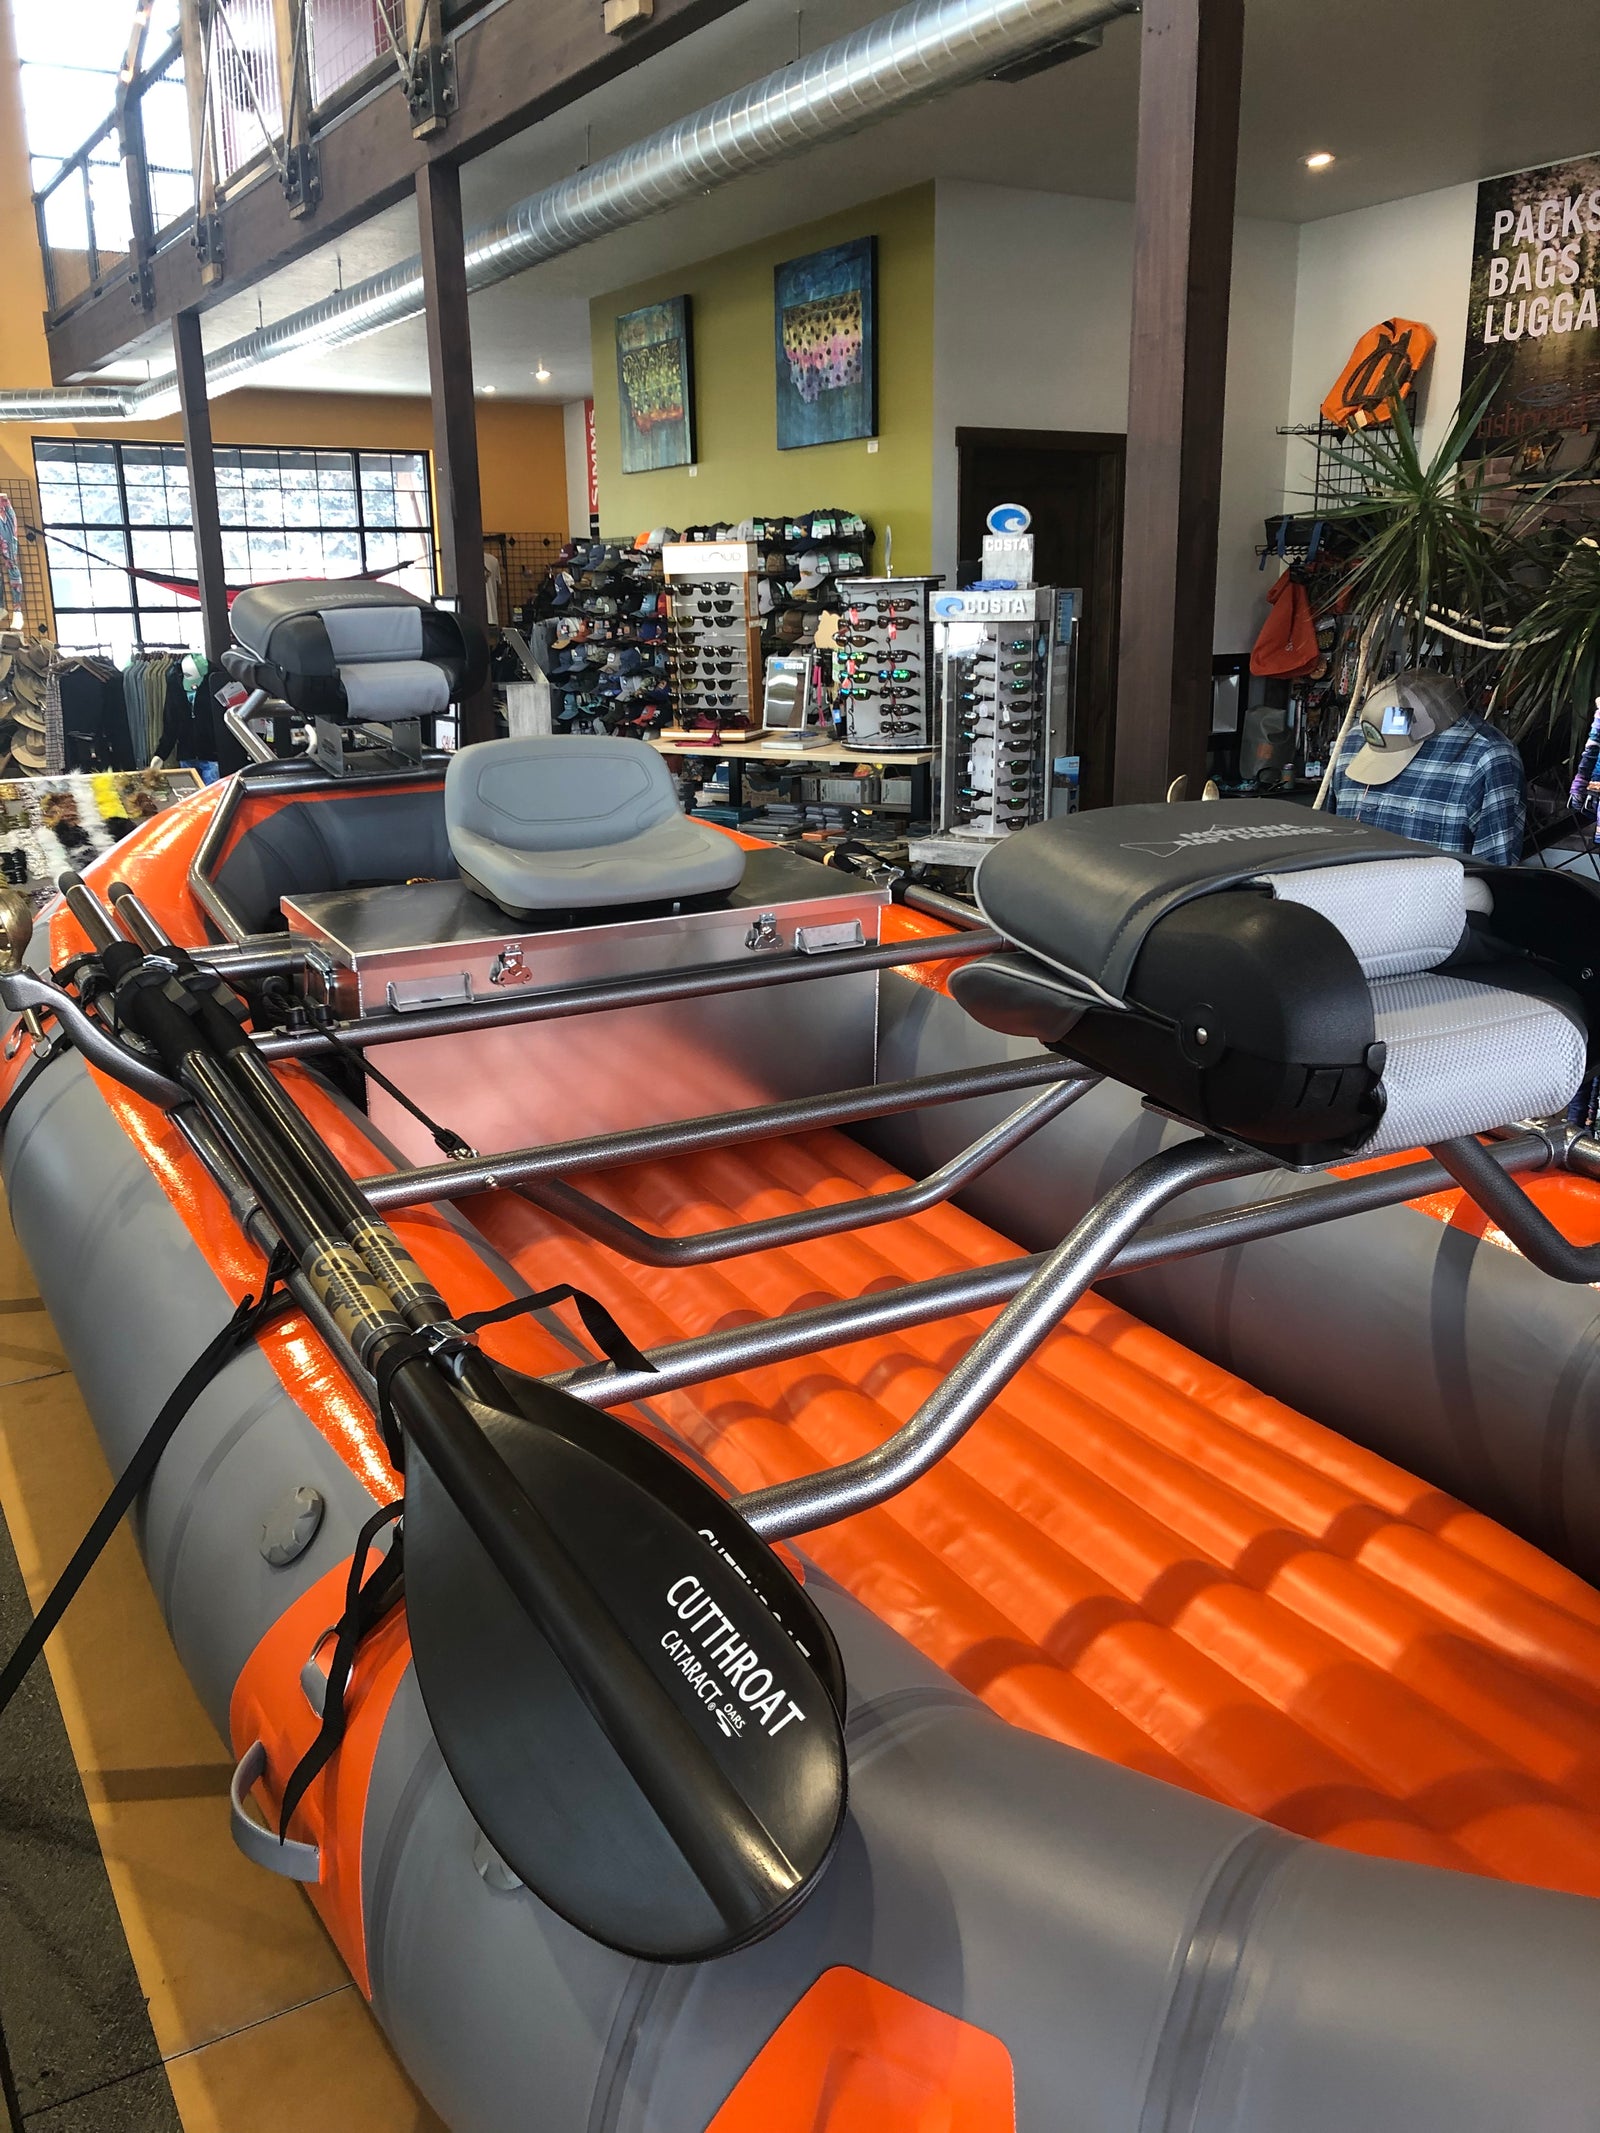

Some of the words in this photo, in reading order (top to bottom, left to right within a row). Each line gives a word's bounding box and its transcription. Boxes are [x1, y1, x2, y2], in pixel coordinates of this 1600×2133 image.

[1493, 190, 1600, 250] PACKS
[1488, 242, 1581, 297] BAGS
[1484, 288, 1599, 343] LUGGA
[985, 537, 1030, 552] COSTA
[964, 597, 1027, 615] COSTA
[1179, 823, 1299, 840] MONTANA
[666, 1575, 806, 1737] CUTTHROAT
[723, 1702, 746, 1730] OARS
